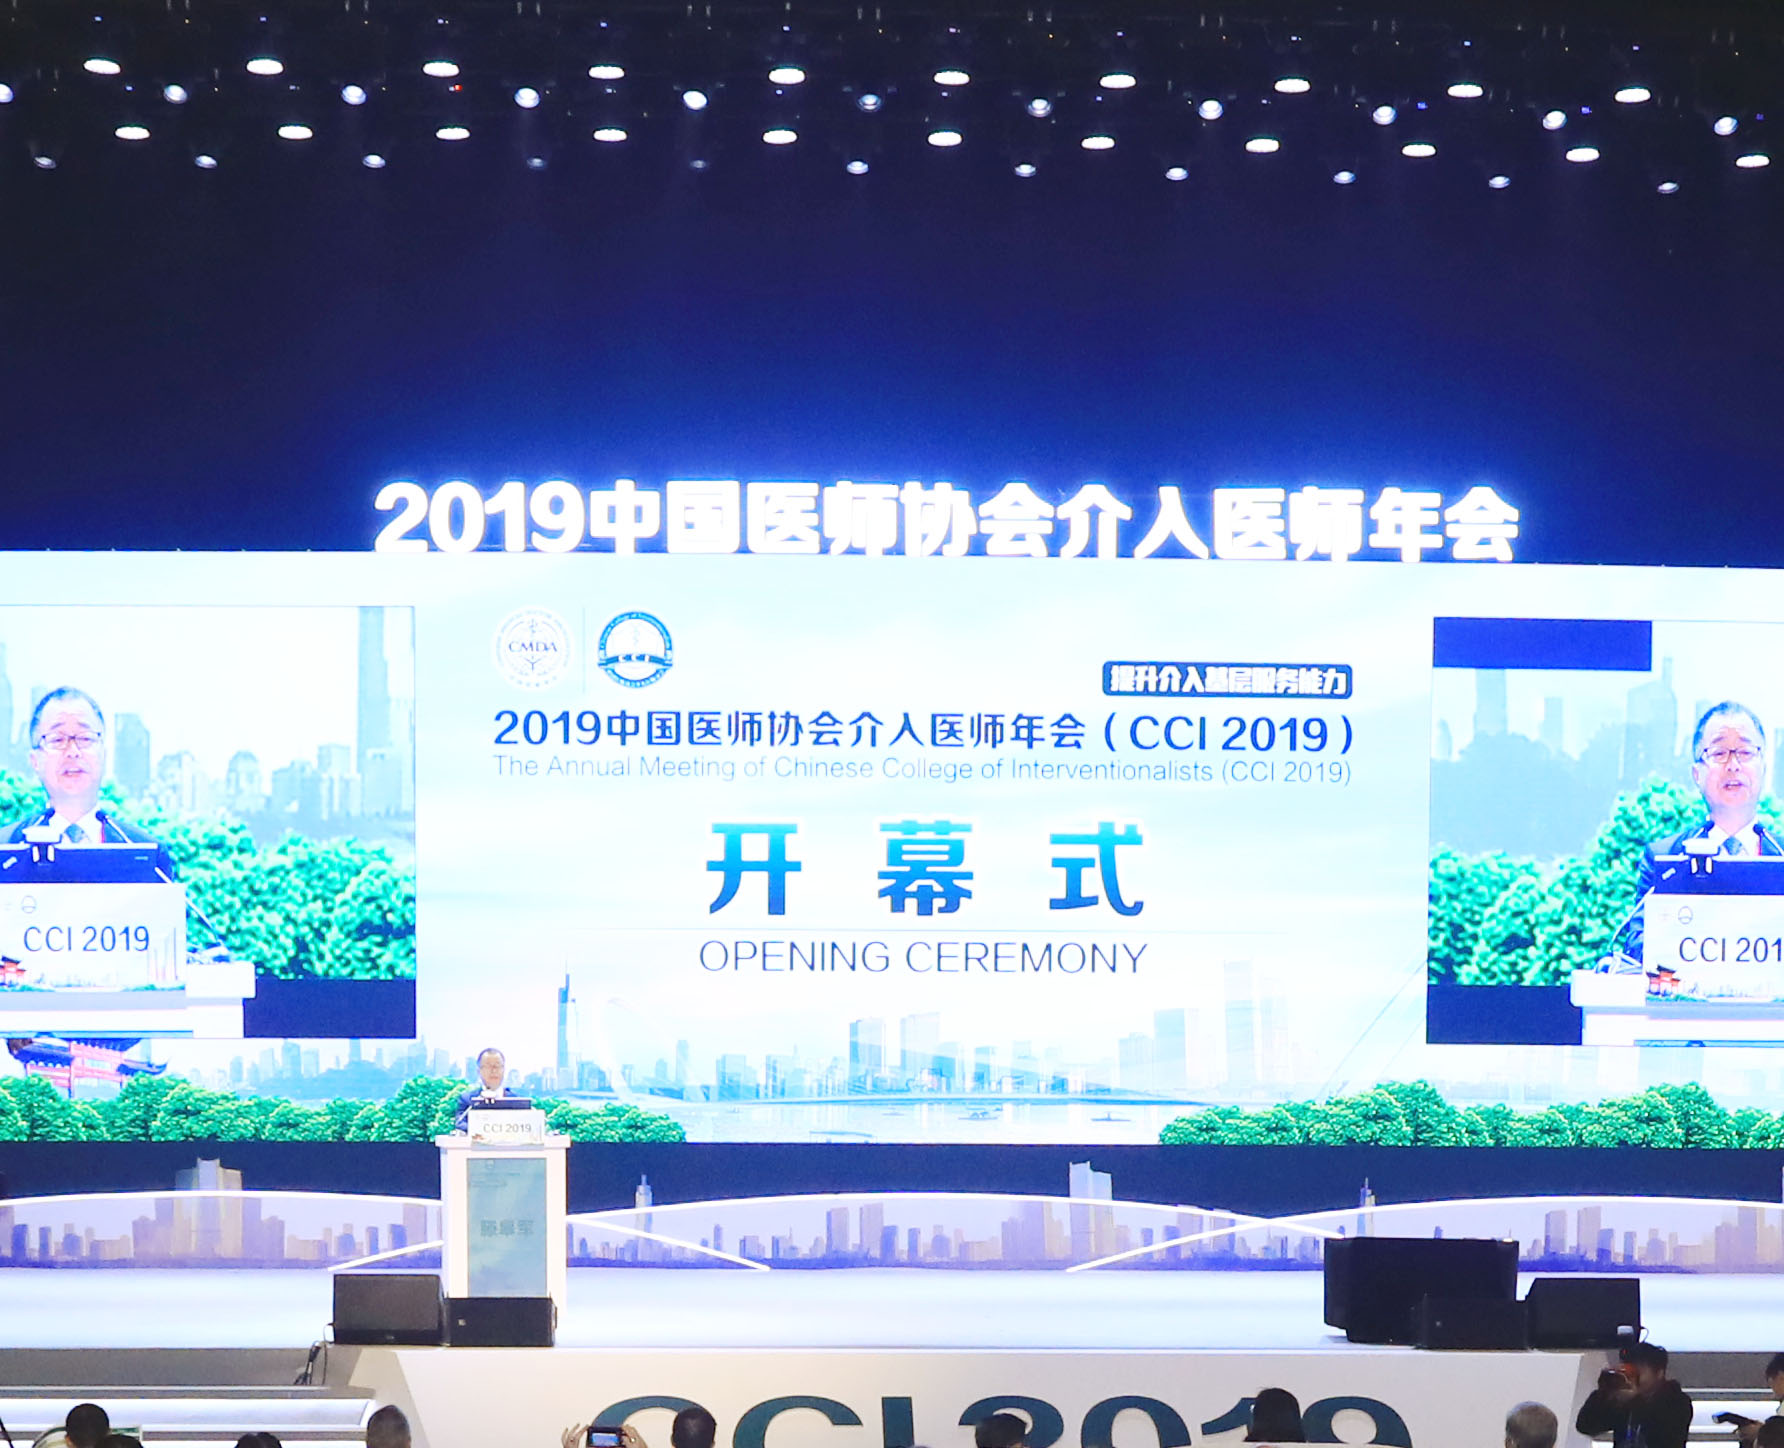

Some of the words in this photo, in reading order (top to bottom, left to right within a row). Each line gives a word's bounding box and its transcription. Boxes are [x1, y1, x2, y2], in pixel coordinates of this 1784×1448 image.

[374, 480, 1519, 562] 2019中国医师协会介入医师年会
[492, 754, 539, 776] The
[546, 755, 630, 777] Annual
[640, 756, 735, 781] Meeting
[744, 756, 767, 777] of
[774, 756, 874, 778] Chinese
[882, 757, 973, 784] College
[981, 758, 1004, 779] of
[1012, 758, 1214, 782] Interventionalists
[1222, 760, 1275, 785] (CCI
[1283, 761, 1353, 787] 2019)
[706, 820, 1144, 917] 开幕式
[24, 926, 72, 952] CCI
[83, 925, 150, 952] 2019
[1679, 937, 1726, 962] CCI
[700, 940, 889, 973] OPENING
[906, 942, 1147, 974] CEREMONY
[483, 1123, 503, 1133] CCI
[506, 1123, 532, 1133] 2019
